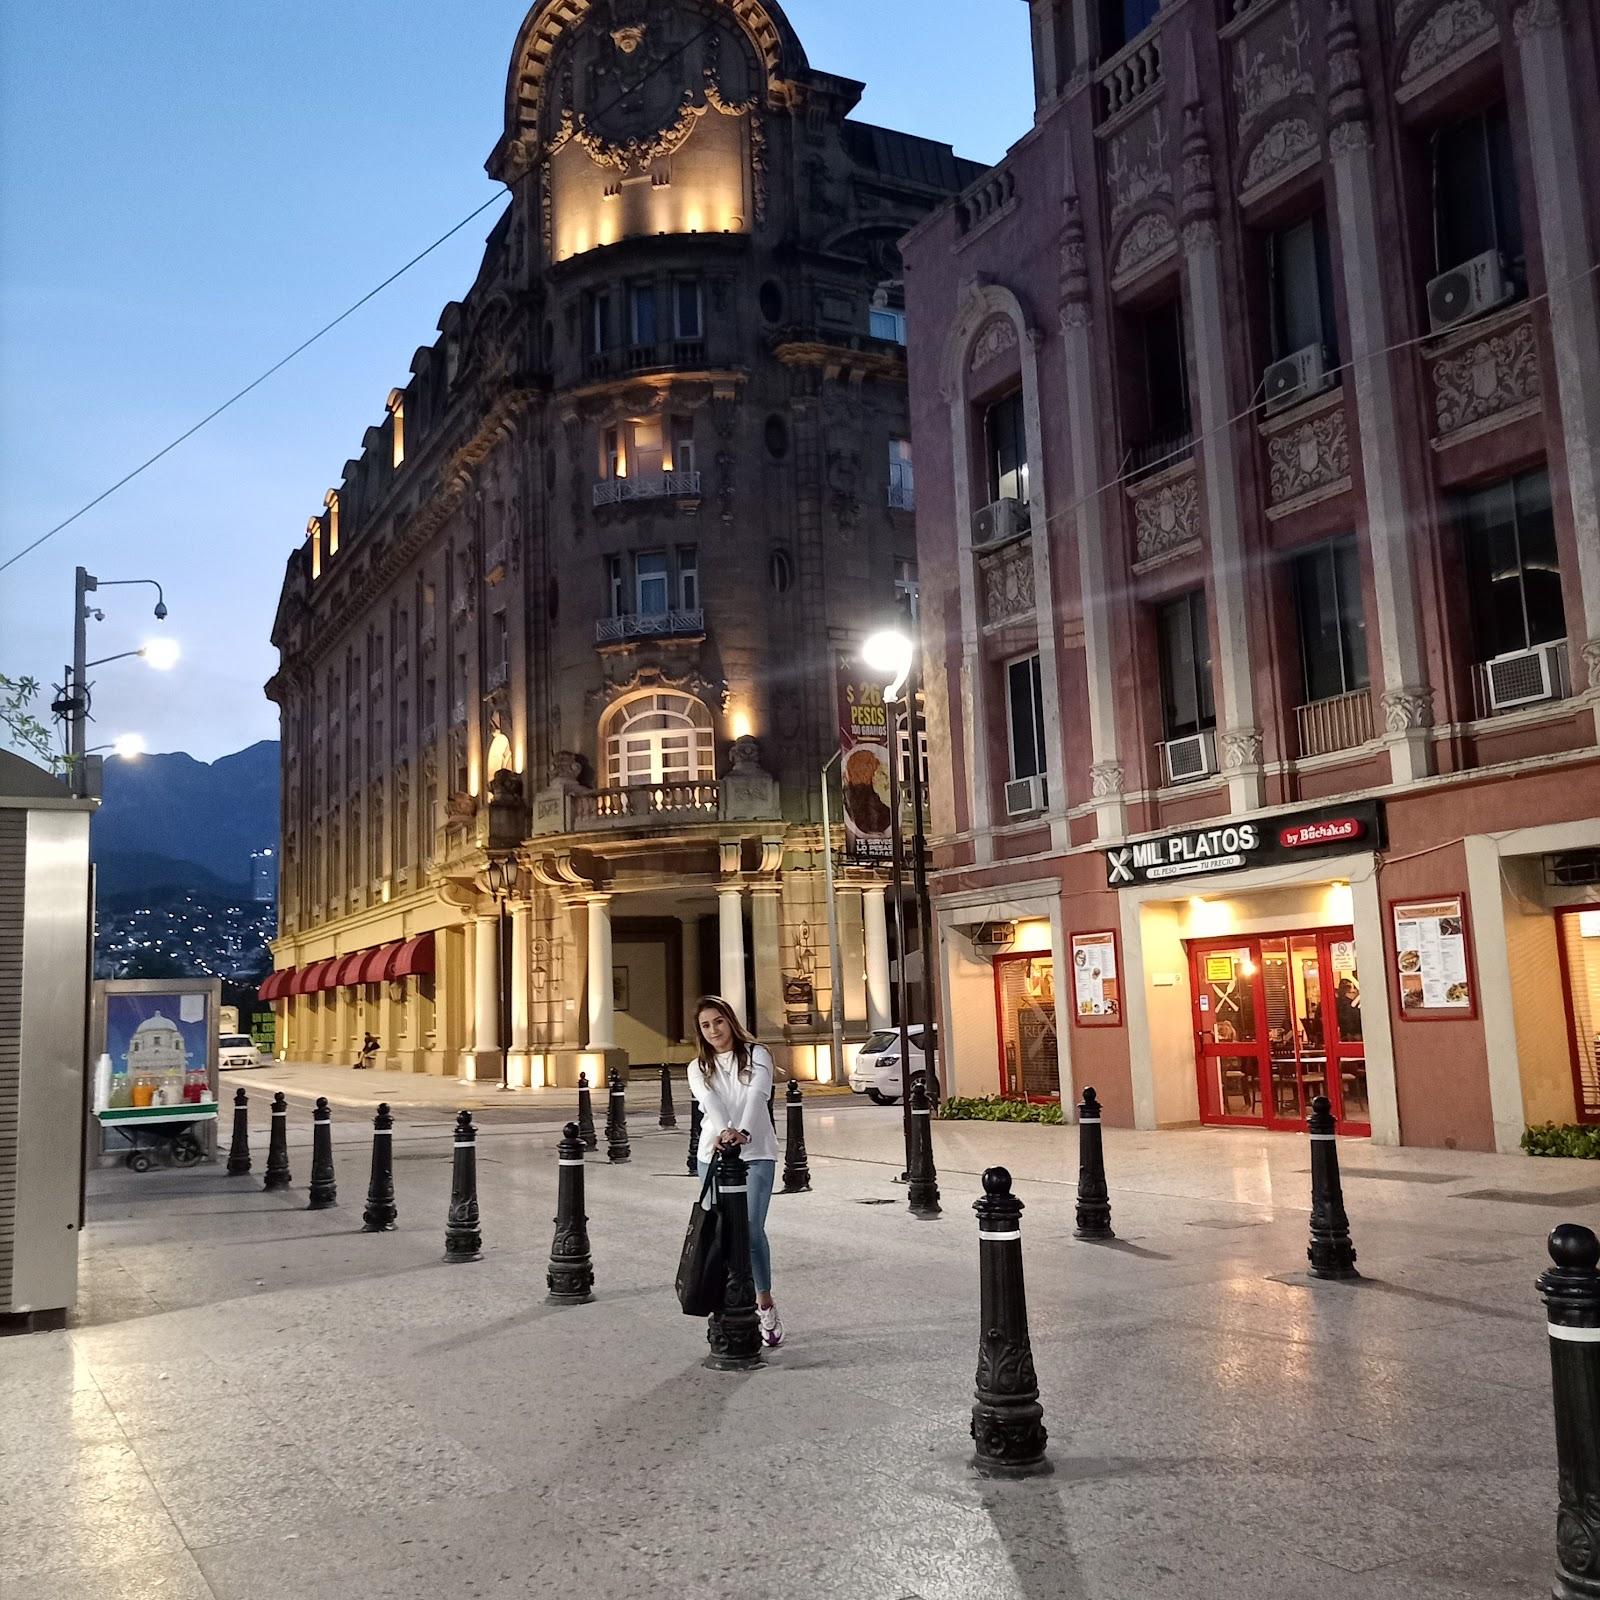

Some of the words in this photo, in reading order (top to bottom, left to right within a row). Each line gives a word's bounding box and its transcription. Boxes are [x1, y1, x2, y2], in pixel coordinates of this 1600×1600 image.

[846, 684, 854, 704] $
[860, 682, 882, 706] 26
[851, 706, 885, 724] PESOS
[861, 726, 886, 736] GRAMOS
[1132, 842, 1163, 868] MIL
[1168, 825, 1256, 862] PLATOS
[1286, 833, 1298, 844] by
[1161, 867, 1177, 876] PESO
[1210, 858, 1235, 868] PRECIO
